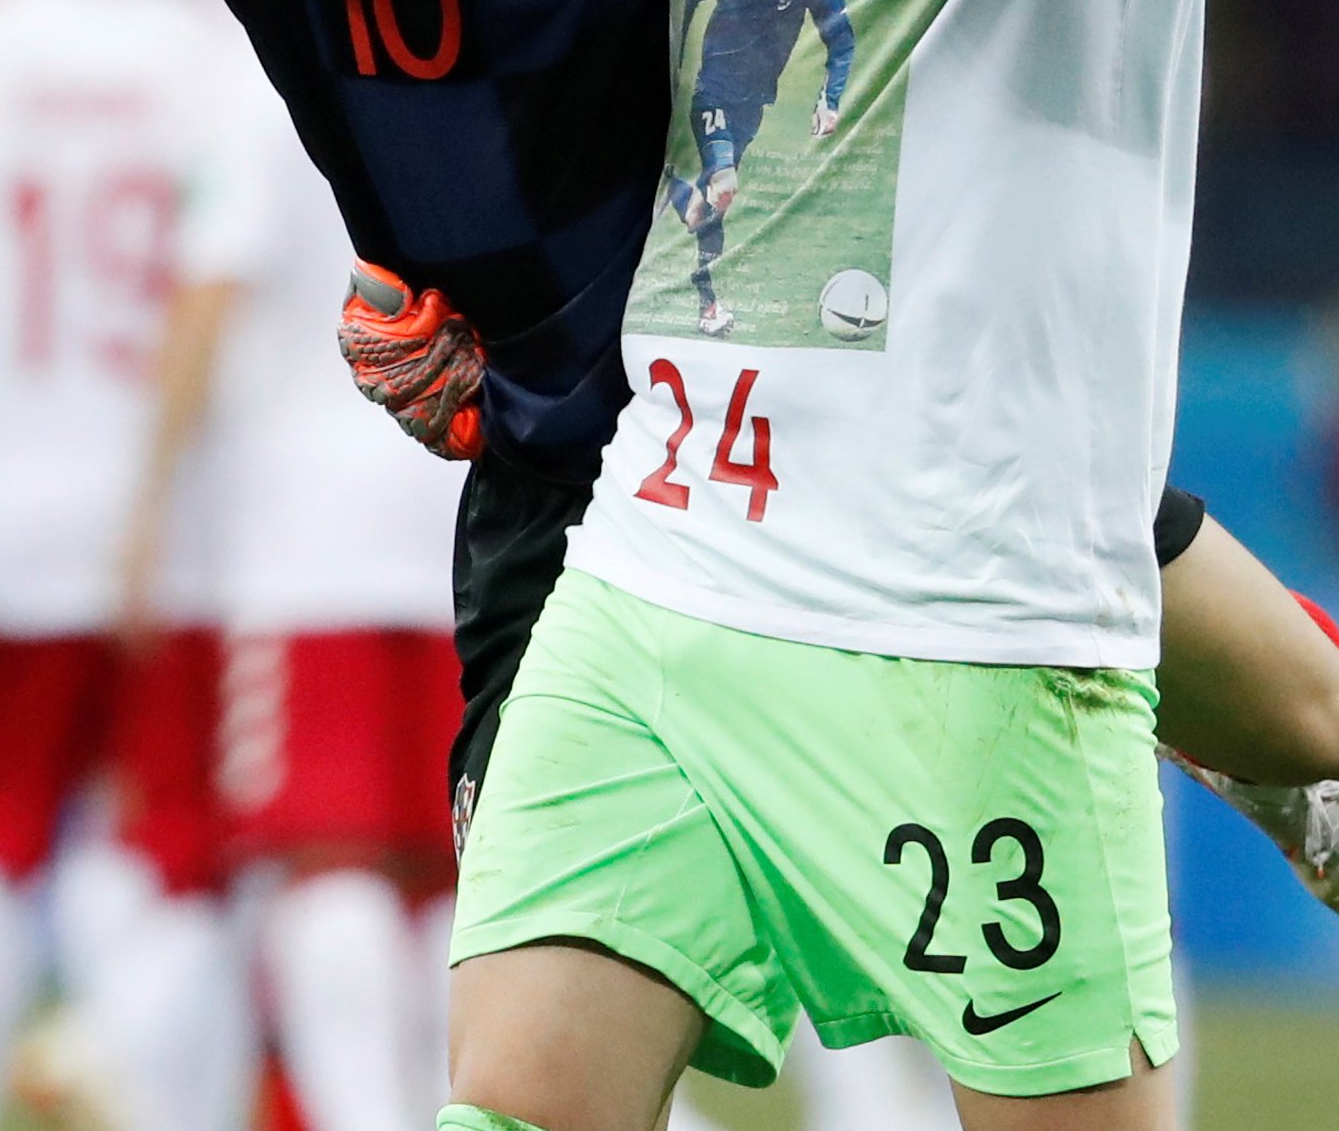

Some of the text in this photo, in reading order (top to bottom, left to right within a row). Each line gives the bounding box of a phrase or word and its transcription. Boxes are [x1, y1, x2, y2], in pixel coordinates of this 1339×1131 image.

[701, 107, 727, 136] 24
[11, 172, 181, 385] 19
[633, 357, 779, 523] 24
[882, 816, 1062, 975] 23
